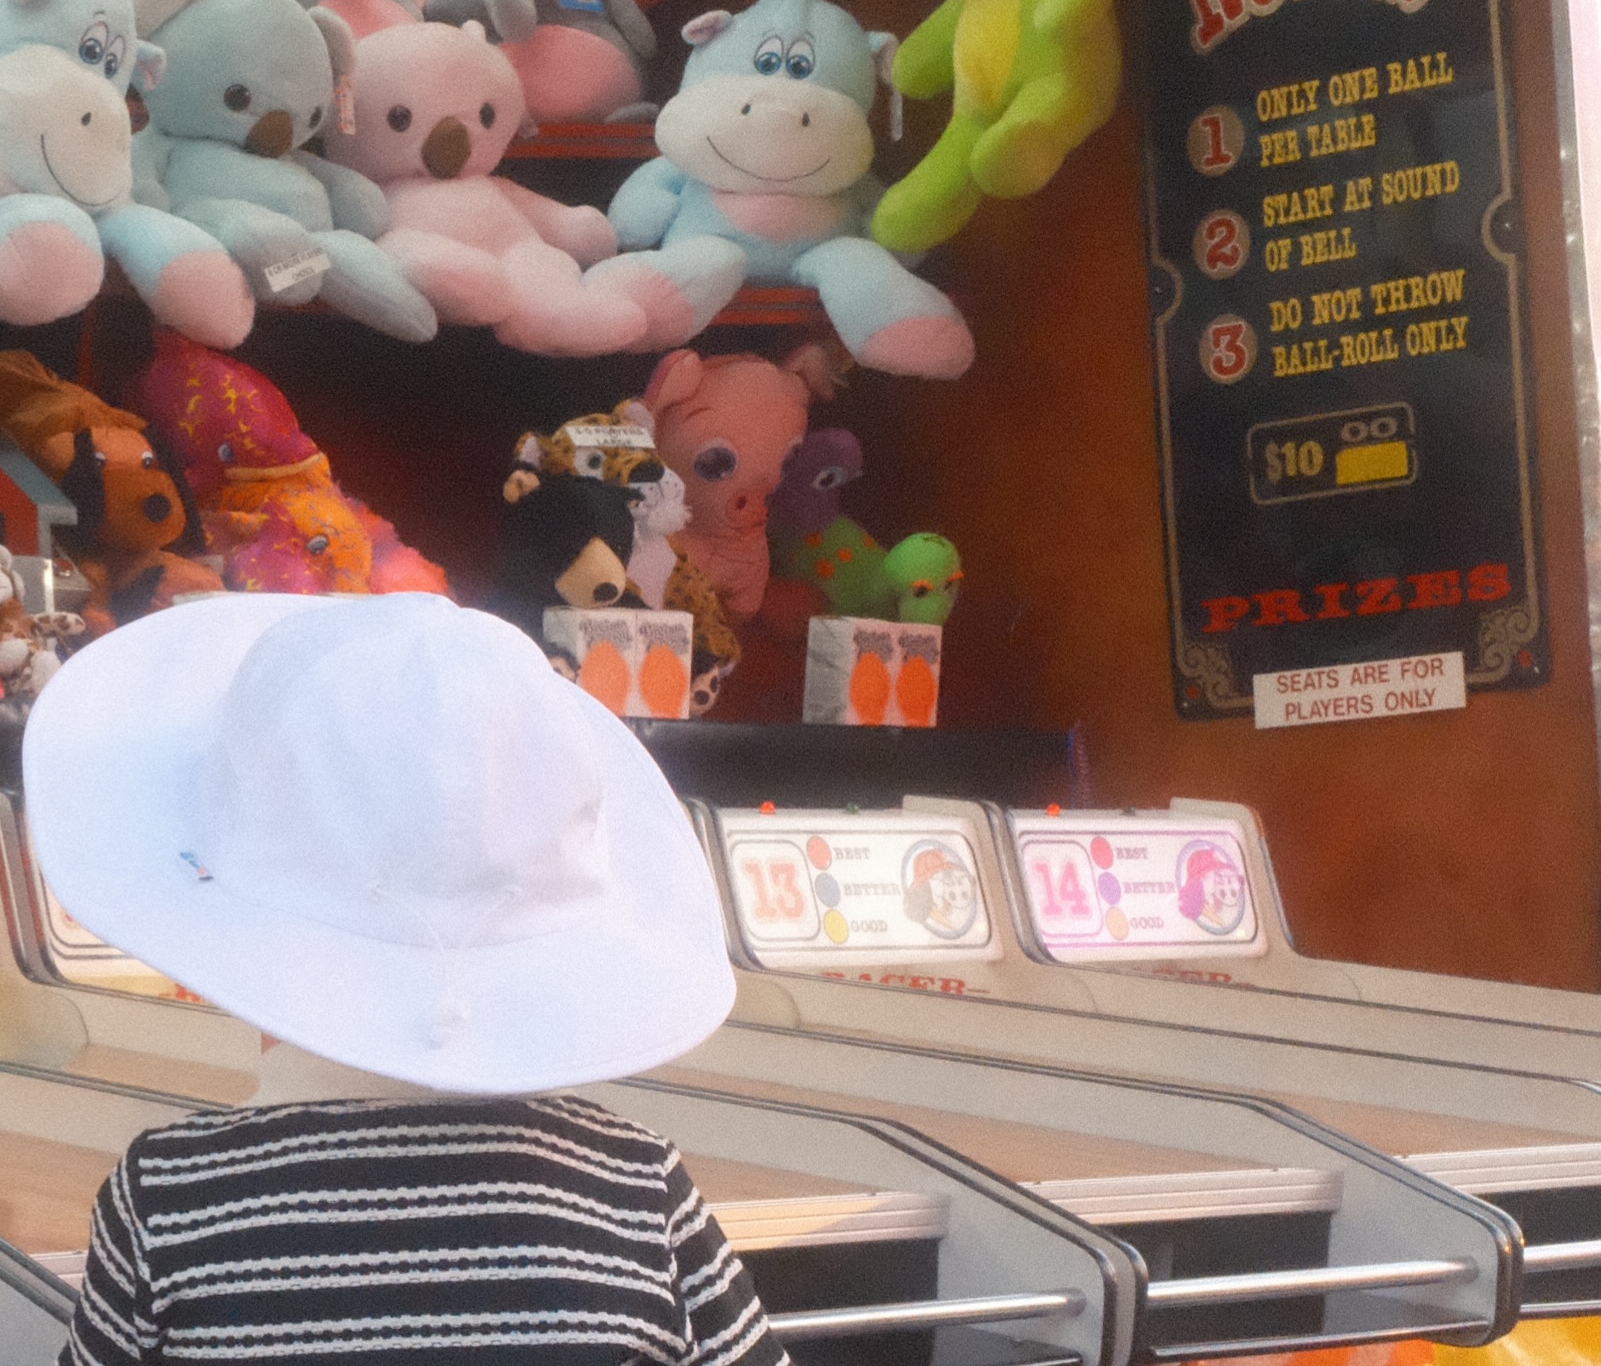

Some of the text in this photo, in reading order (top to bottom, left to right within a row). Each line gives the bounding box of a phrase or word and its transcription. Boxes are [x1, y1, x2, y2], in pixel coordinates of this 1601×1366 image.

[1256, 51, 1454, 122] ONLY ONE BALL
[1200, 116, 1233, 168] 1
[1259, 113, 1376, 168] PER TABLE
[1262, 160, 1460, 228] START AT SOUND
[1204, 217, 1242, 271] 2
[1264, 227, 1357, 272] OF BELL
[1269, 268, 1466, 332] DO NOT THROW
[1210, 323, 1248, 377] 3
[1272, 316, 1469, 377] BALL-ROLL ONLY
[1265, 440, 1324, 484] $10
[1200, 563, 1512, 633] PRIZES
[1277, 657, 1444, 695] SEATS ARE FOR
[1285, 688, 1436, 721] PLAYERS ONLY
[833, 847, 871, 861] BEST
[1116, 847, 1148, 860] BEST
[744, 861, 805, 919] 13
[843, 883, 902, 897] BETTER
[1034, 860, 1091, 916] 14
[1123, 881, 1176, 895] BETTER
[850, 919, 888, 934] GOOD
[1130, 916, 1164, 930] GOOD
